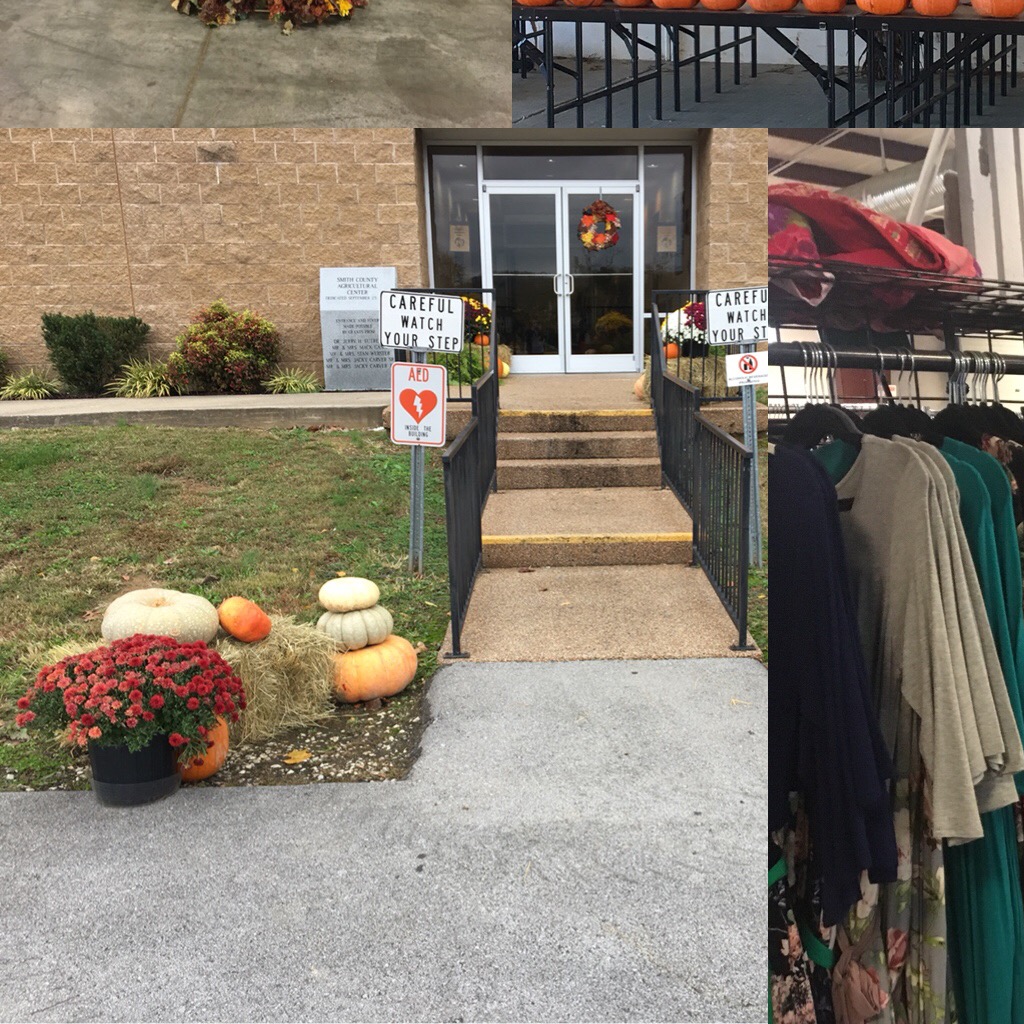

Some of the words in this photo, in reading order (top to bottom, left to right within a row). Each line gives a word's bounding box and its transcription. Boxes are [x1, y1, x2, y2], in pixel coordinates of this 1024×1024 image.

[390, 294, 454, 313] CAREFUL
[715, 289, 768, 307] CAREFU
[401, 315, 443, 331] WATCH
[727, 309, 767, 324] WATCH
[384, 332, 418, 347] YOUR
[428, 335, 459, 350] STEP
[712, 328, 744, 342] YOUR
[754, 326, 767, 339] ST
[408, 367, 429, 382] AED
